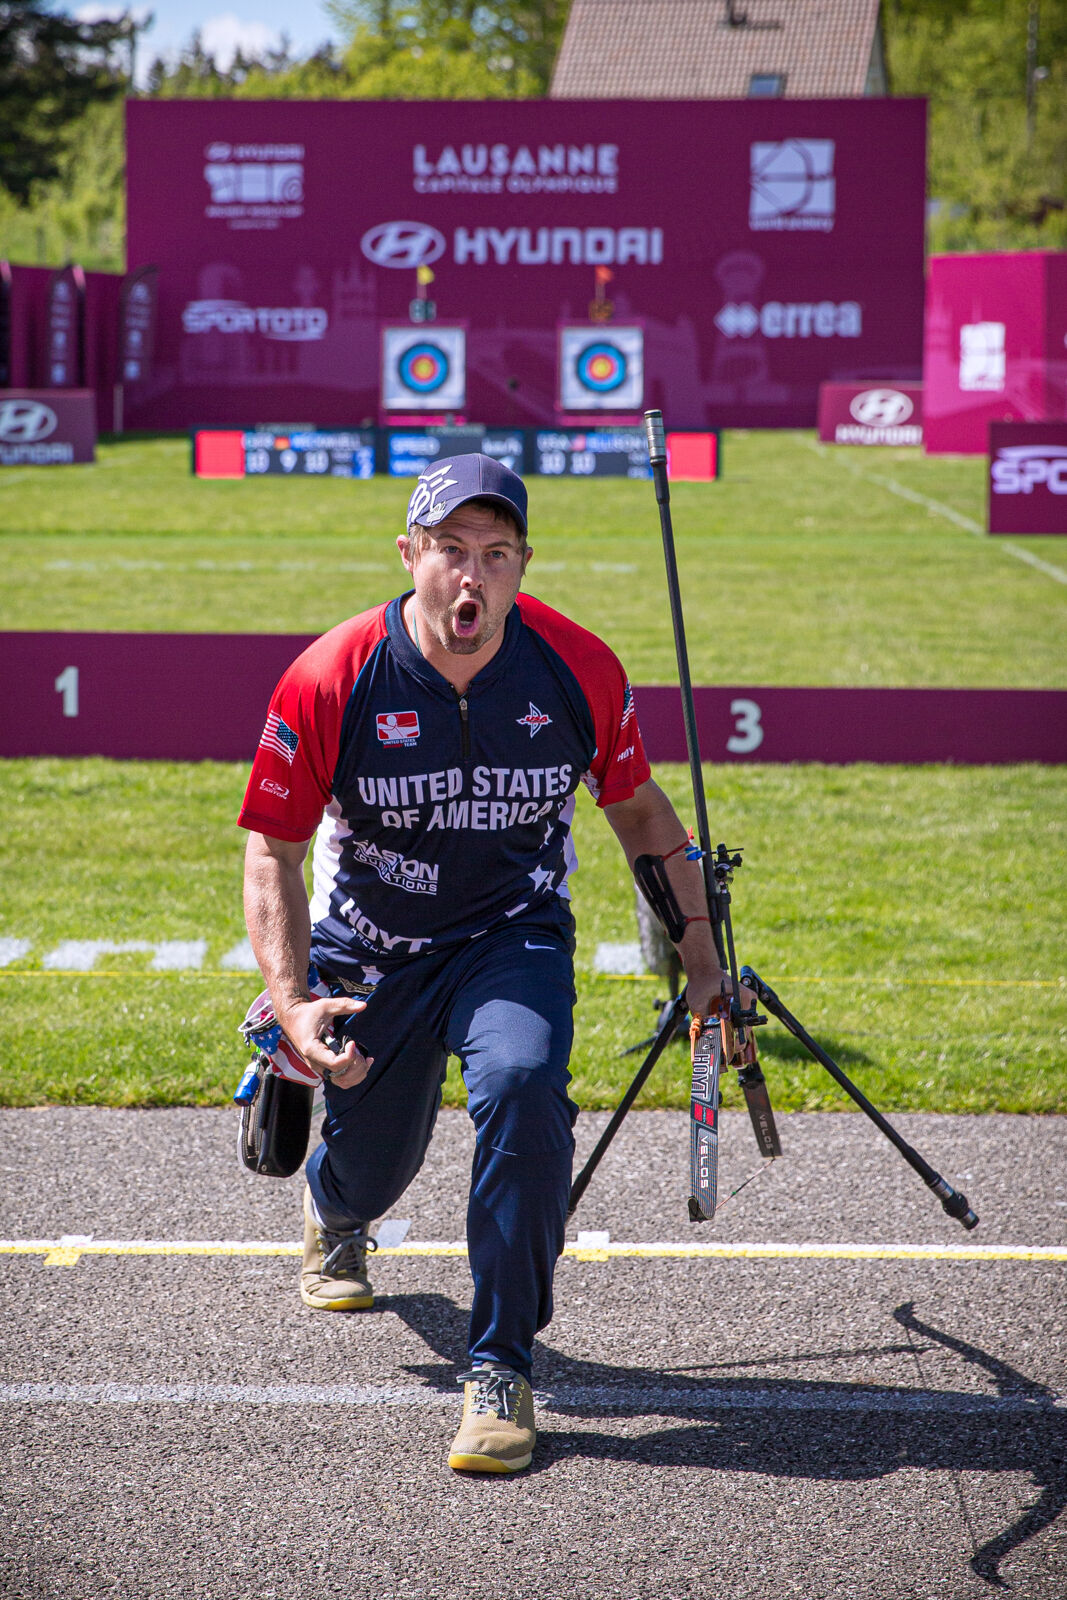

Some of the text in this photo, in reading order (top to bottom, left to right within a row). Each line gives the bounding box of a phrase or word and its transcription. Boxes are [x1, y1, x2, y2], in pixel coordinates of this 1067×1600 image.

[413, 143, 619, 175] LAUSANNE
[413, 175, 618, 194] CAPITALE OLYMPIQUE
[453, 227, 664, 265] HYUNDAI
[0, 442, 74, 464] UNDAI
[55, 665, 79, 718] 1
[726, 698, 764, 754] 3
[357, 763, 573, 807] UNITED STATES
[381, 808, 420, 829] OF
[353, 849, 438, 893] FOUNDATIONS
[339, 897, 432, 954] HOYT
[691, 1053, 711, 1100] HOYT
[700, 1135, 709, 1190] VELOS
